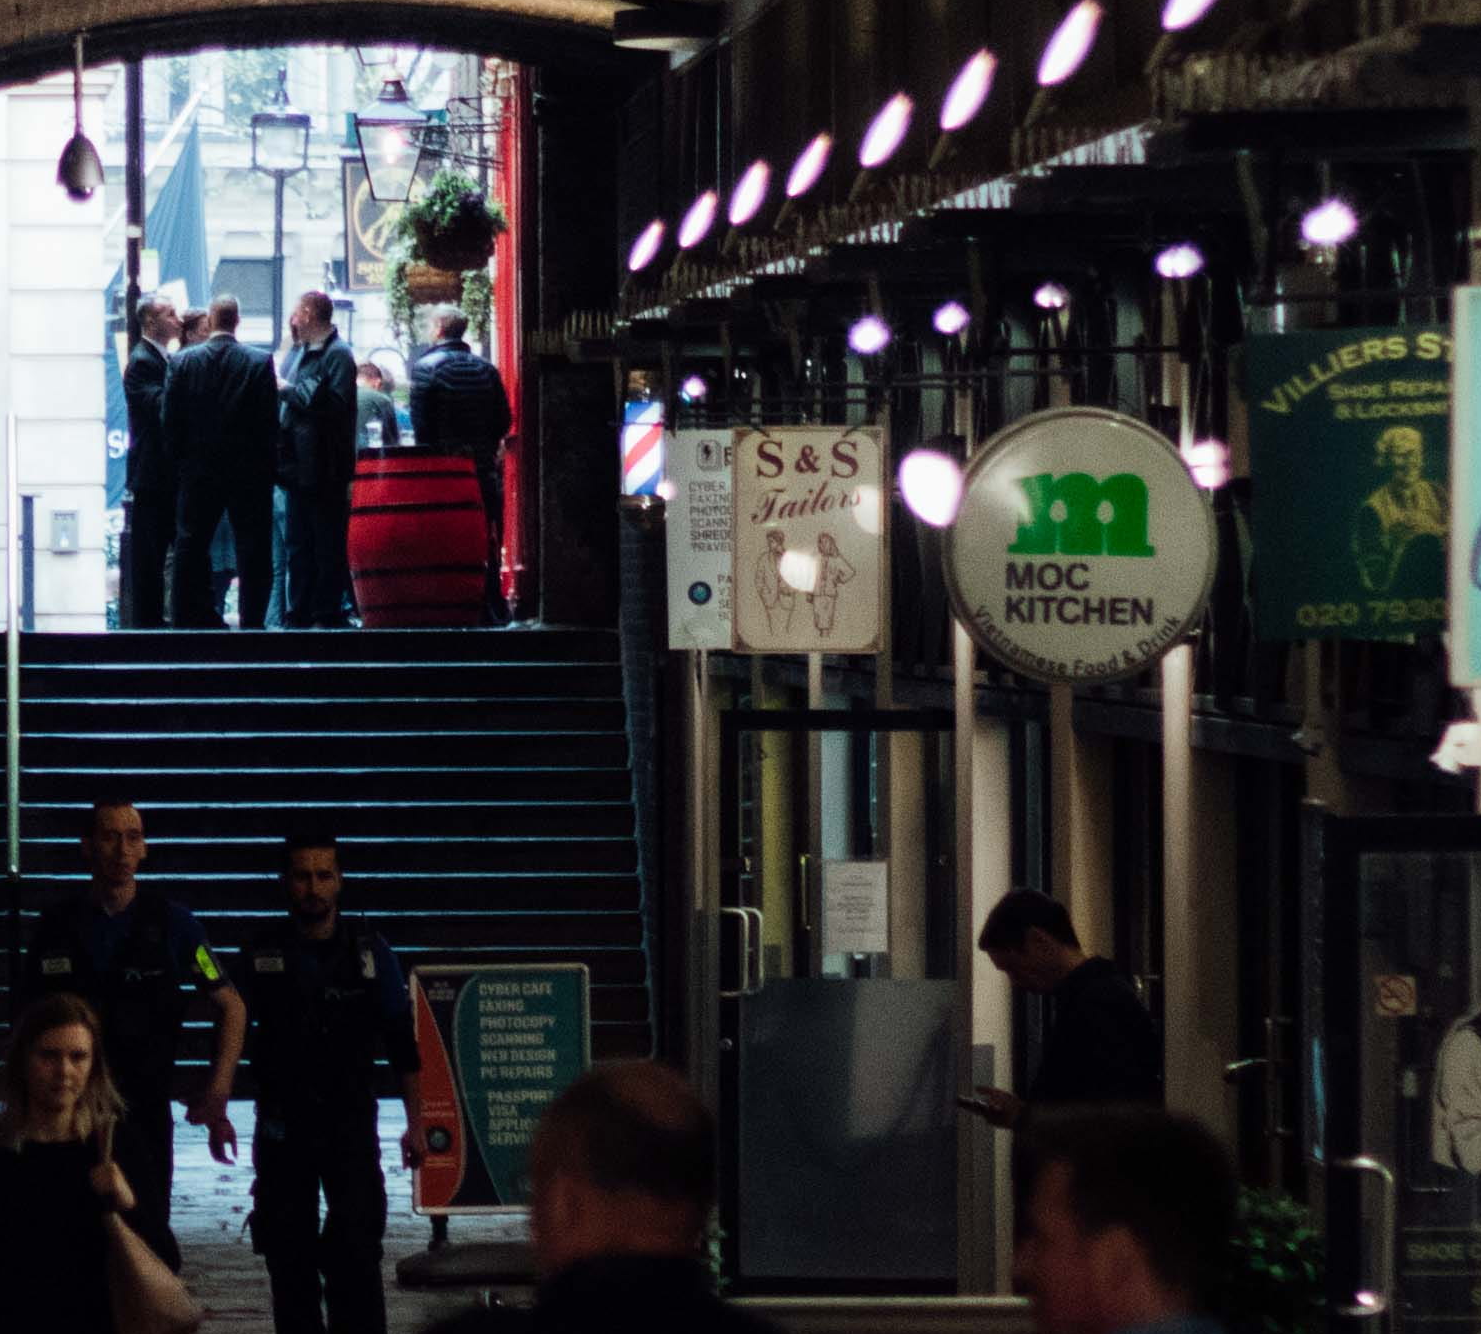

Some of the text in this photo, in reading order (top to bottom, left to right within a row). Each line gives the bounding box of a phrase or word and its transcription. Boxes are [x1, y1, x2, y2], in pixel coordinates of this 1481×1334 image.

[1260, 335, 1408, 414] VILLIERS
[1388, 380, 1452, 396] REPA
[756, 440, 785, 479] S
[794, 444, 820, 475] &
[830, 440, 859, 479] S
[751, 480, 863, 525] Tailors
[1005, 562, 1090, 590] MOC
[1005, 595, 1154, 626] KITCHEN
[1295, 603, 1360, 628] 020
[974, 604, 1182, 676] Vietnamese Food & Drink
[478, 982, 553, 996] CYBER CAFE
[478, 999, 525, 1013] FAXING
[479, 1015, 557, 1030] PHOTOCOPY
[479, 1032, 545, 1046] SCANNING
[480, 1049, 558, 1062] WEB DESIGN
[481, 1065, 554, 1080] PC REPAIRS
[488, 1104, 518, 1117] VISA
[488, 1118, 540, 1132] APPLIC
[488, 1131, 534, 1146] SERVI
